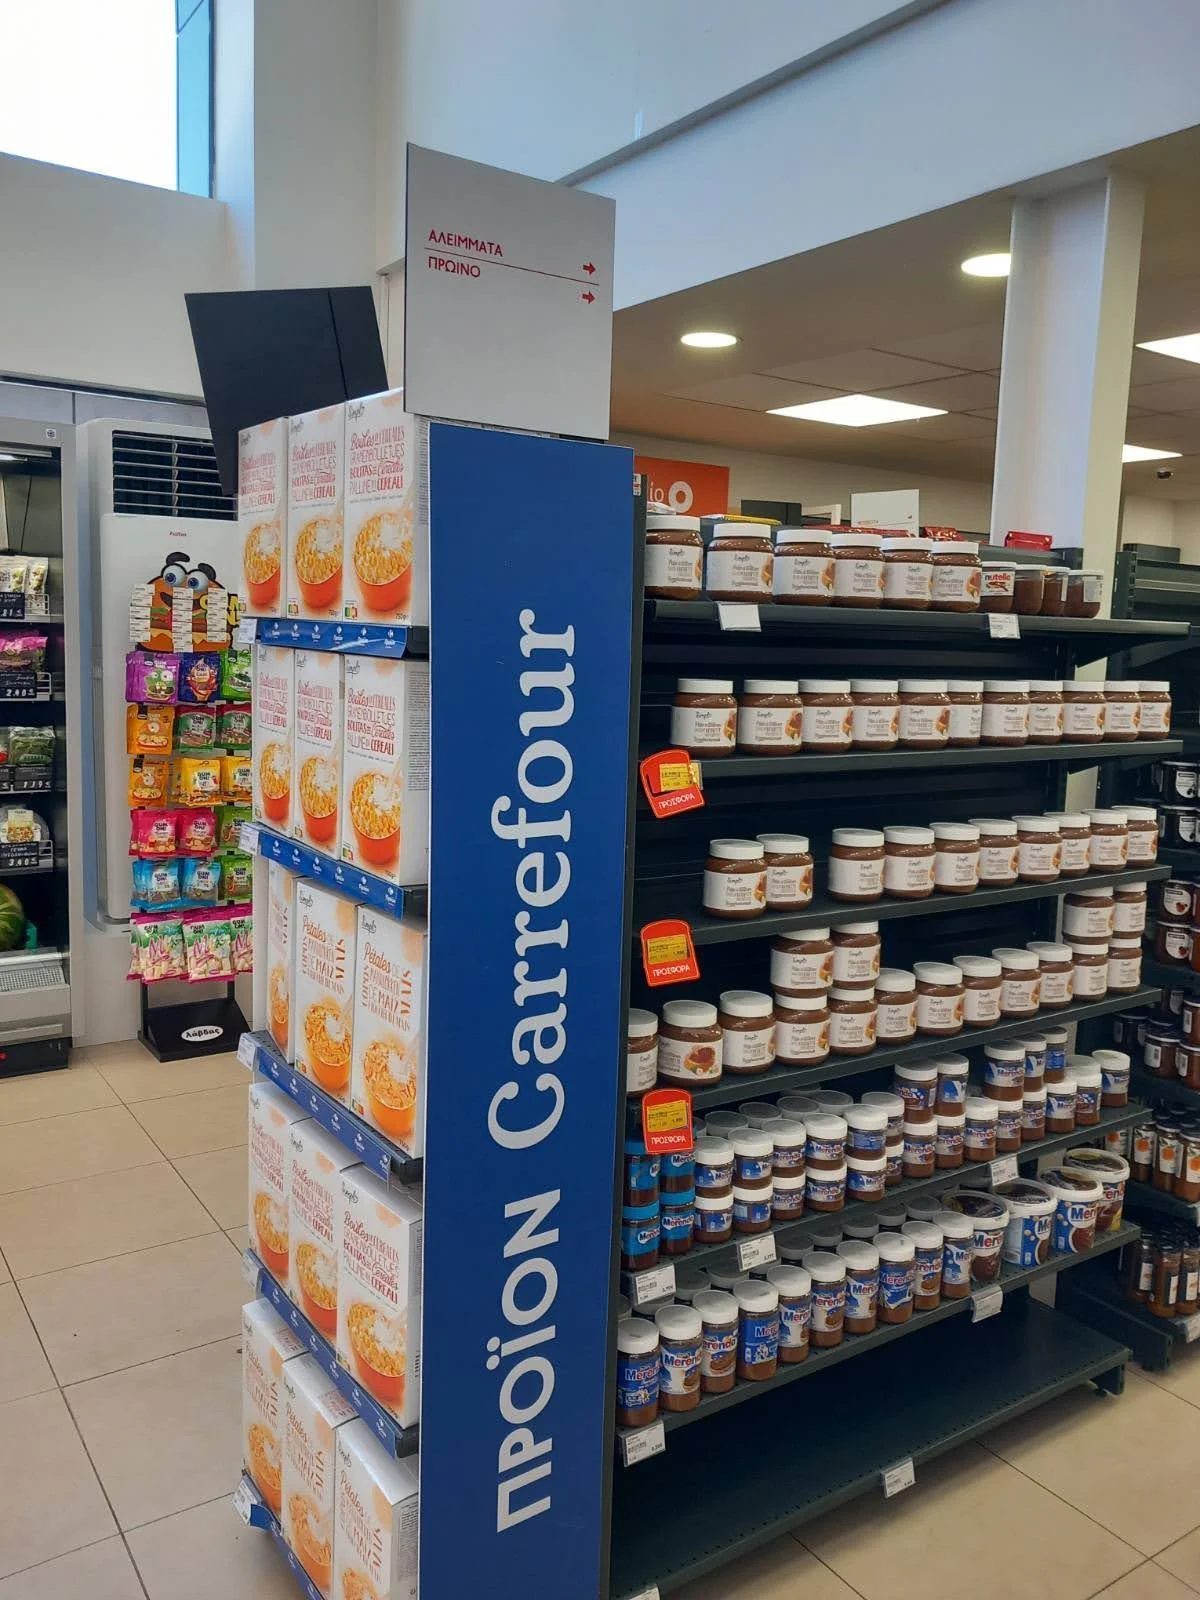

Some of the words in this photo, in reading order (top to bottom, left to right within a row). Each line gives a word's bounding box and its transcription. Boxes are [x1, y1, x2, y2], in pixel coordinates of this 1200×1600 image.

[428, 229, 504, 258] ΑΛΕΙΜΜΑΤΑ
[428, 256, 481, 278] ΠΡΩΙΝΟ
[659, 793, 695, 809] ΠΡΟΣΦΟΡΑ
[488, 609, 574, 1148] Carrefour
[653, 965, 690, 977] ΠΡΟΣΦΟΡΑ
[186, 1028, 220, 1038] λάβδας
[651, 1136, 686, 1145] ΠΡΟΣΦΟΡΑ
